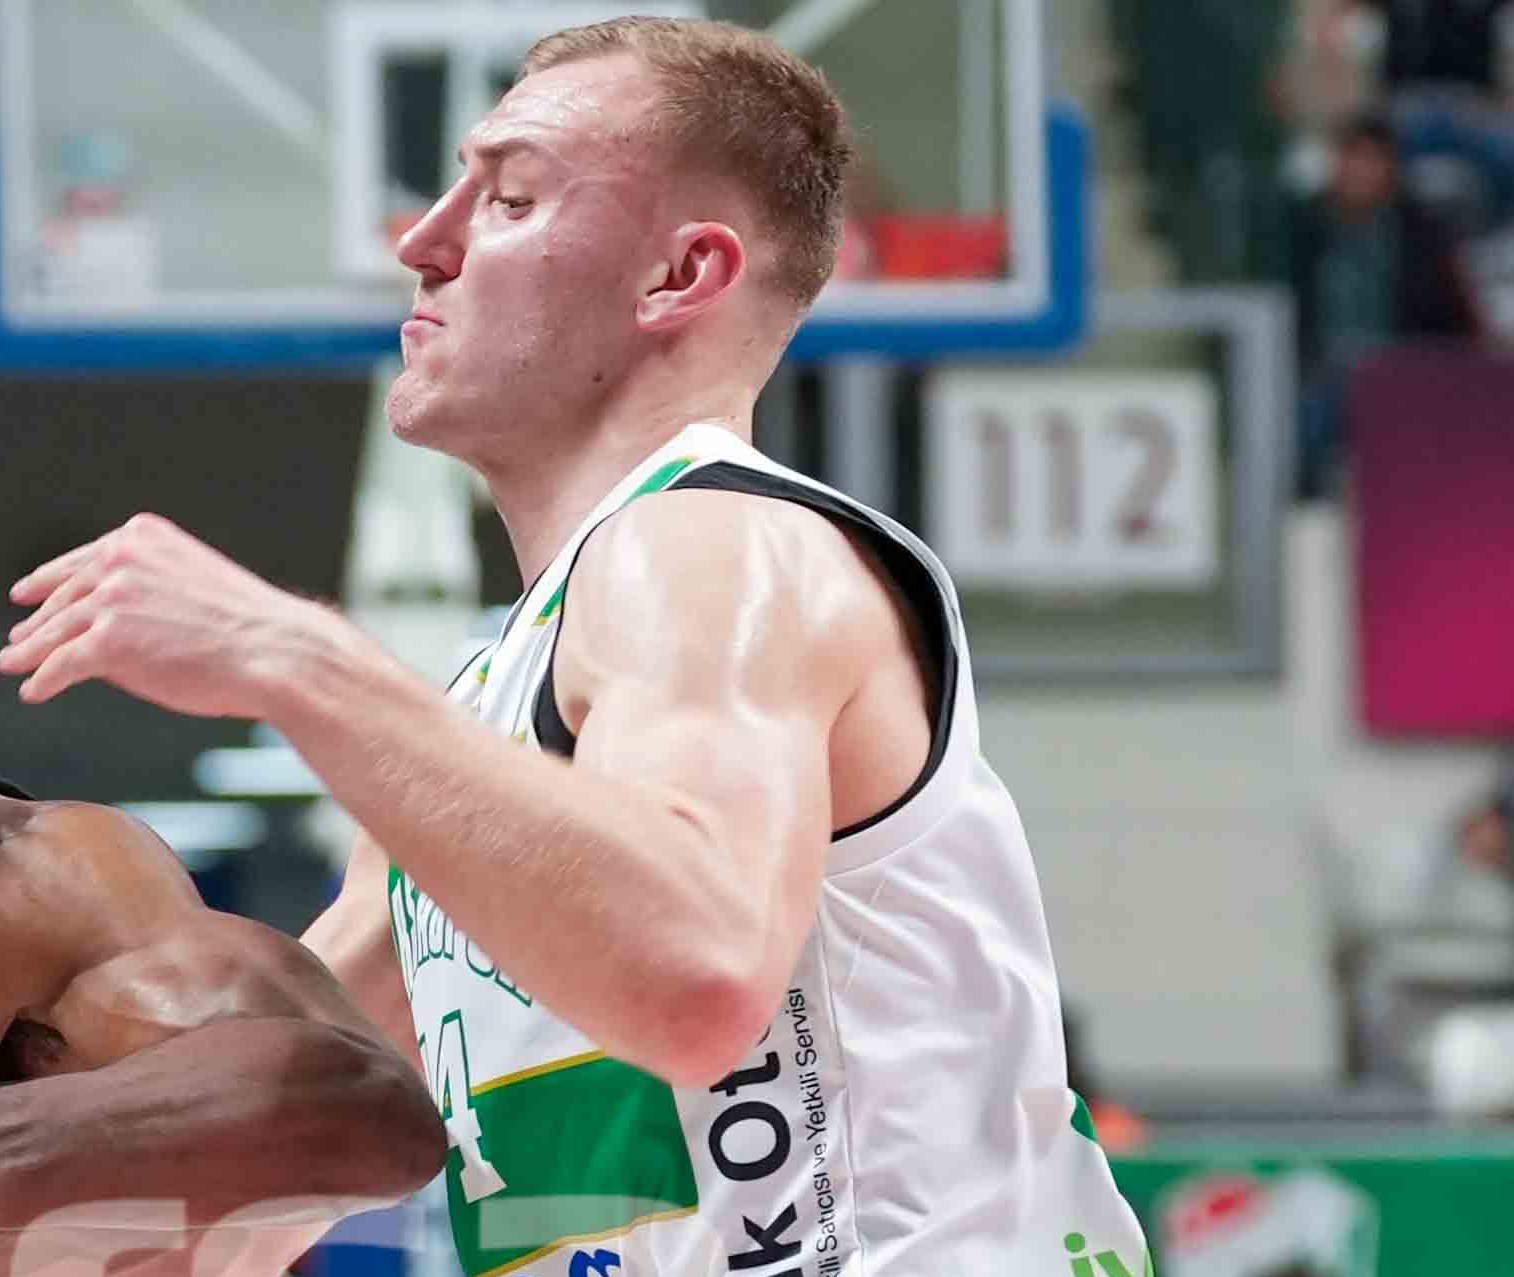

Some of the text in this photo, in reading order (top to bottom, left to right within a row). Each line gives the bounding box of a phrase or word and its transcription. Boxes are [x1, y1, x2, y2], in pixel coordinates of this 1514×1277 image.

[972, 406, 1179, 546] 112
[709, 1025, 791, 1182] Ot
[798, 1071, 827, 1141] Yetkili
